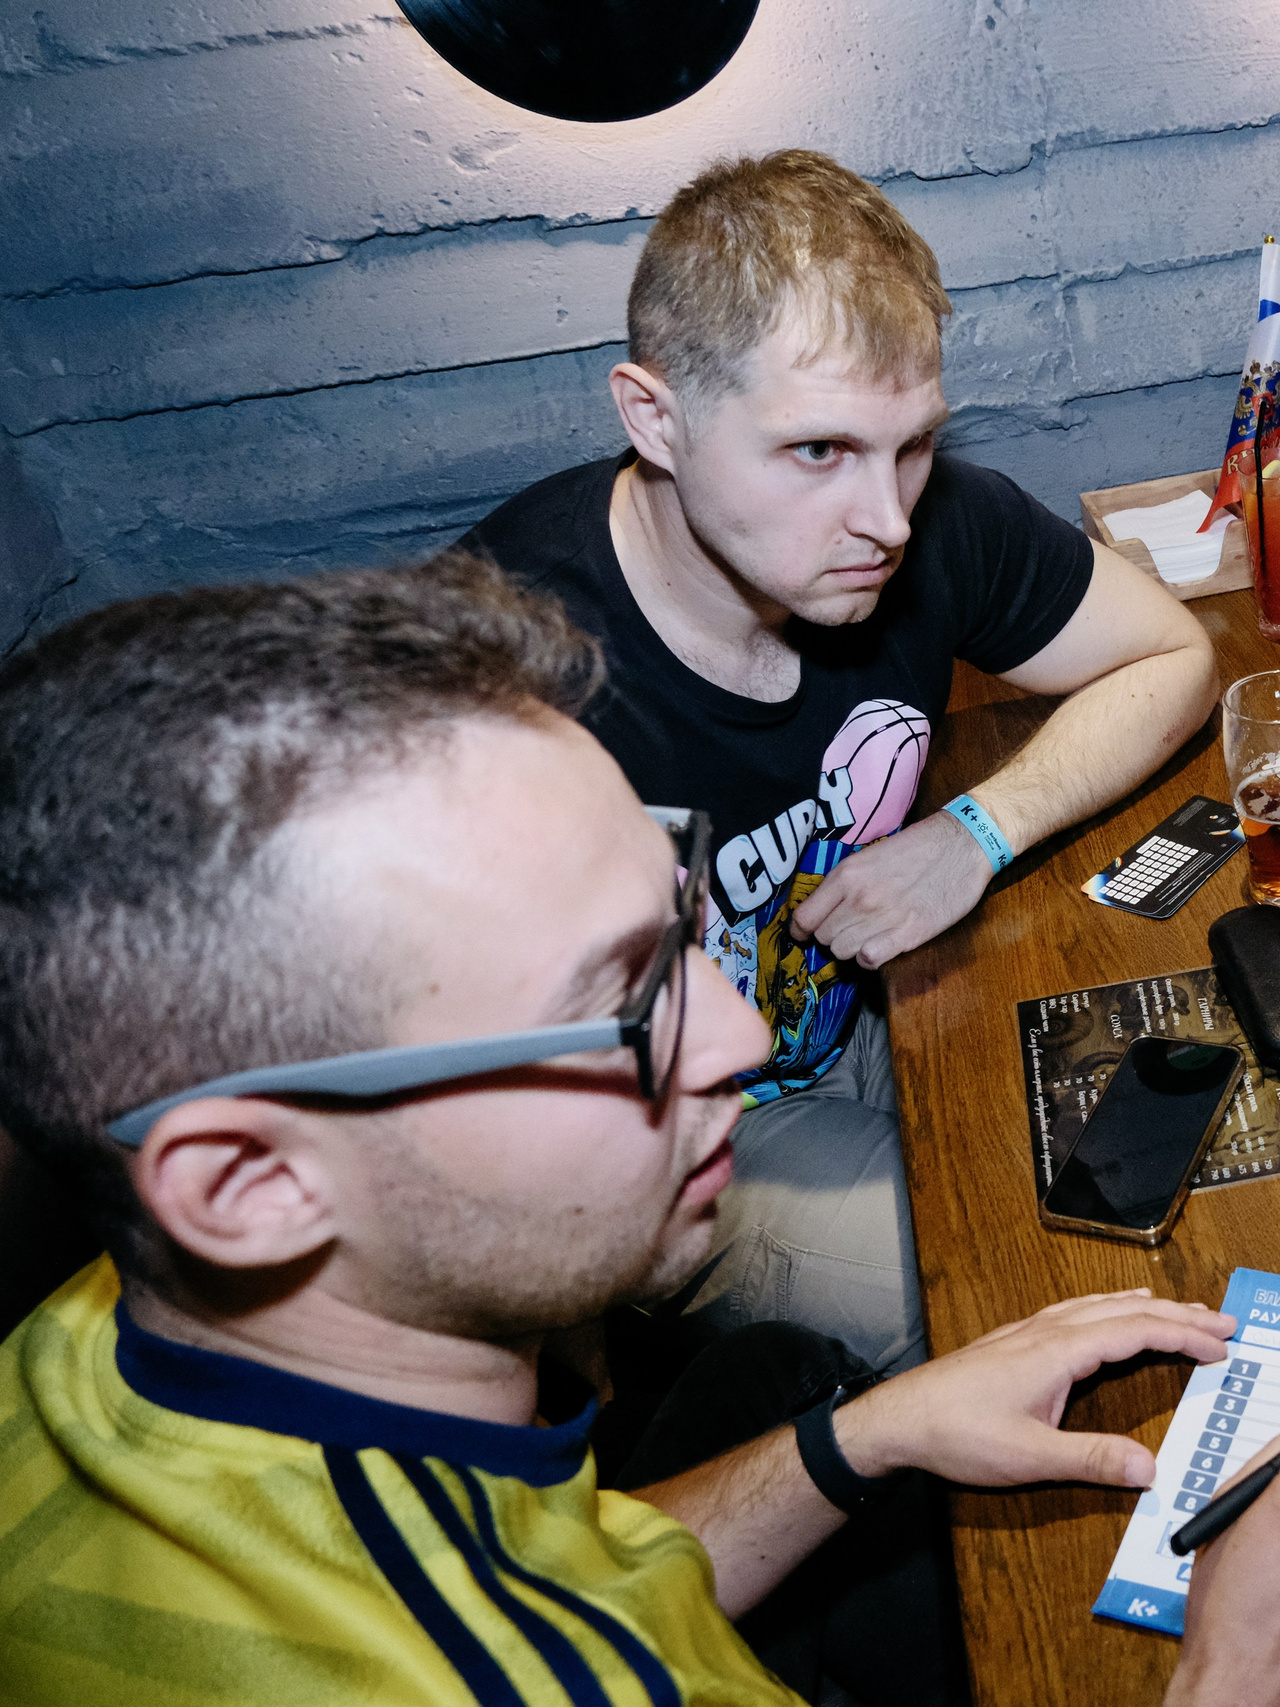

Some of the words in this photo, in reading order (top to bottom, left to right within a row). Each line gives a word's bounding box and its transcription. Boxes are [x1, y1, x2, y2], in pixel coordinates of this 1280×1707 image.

[1047, 997, 1057, 1009] BBQ
[1198, 997, 1214, 1031] ГАРНИРЫ
[1109, 1013, 1122, 1039] СОУСА
[1240, 1363, 1249, 1374] 1
[1231, 1379, 1243, 1393] 2
[1223, 1397, 1236, 1411] 3
[1215, 1416, 1228, 1430] 4
[1208, 1436, 1221, 1449] 5
[1200, 1455, 1213, 1469] 6
[1192, 1475, 1206, 1489] 7
[1184, 1495, 1197, 1510] 8
